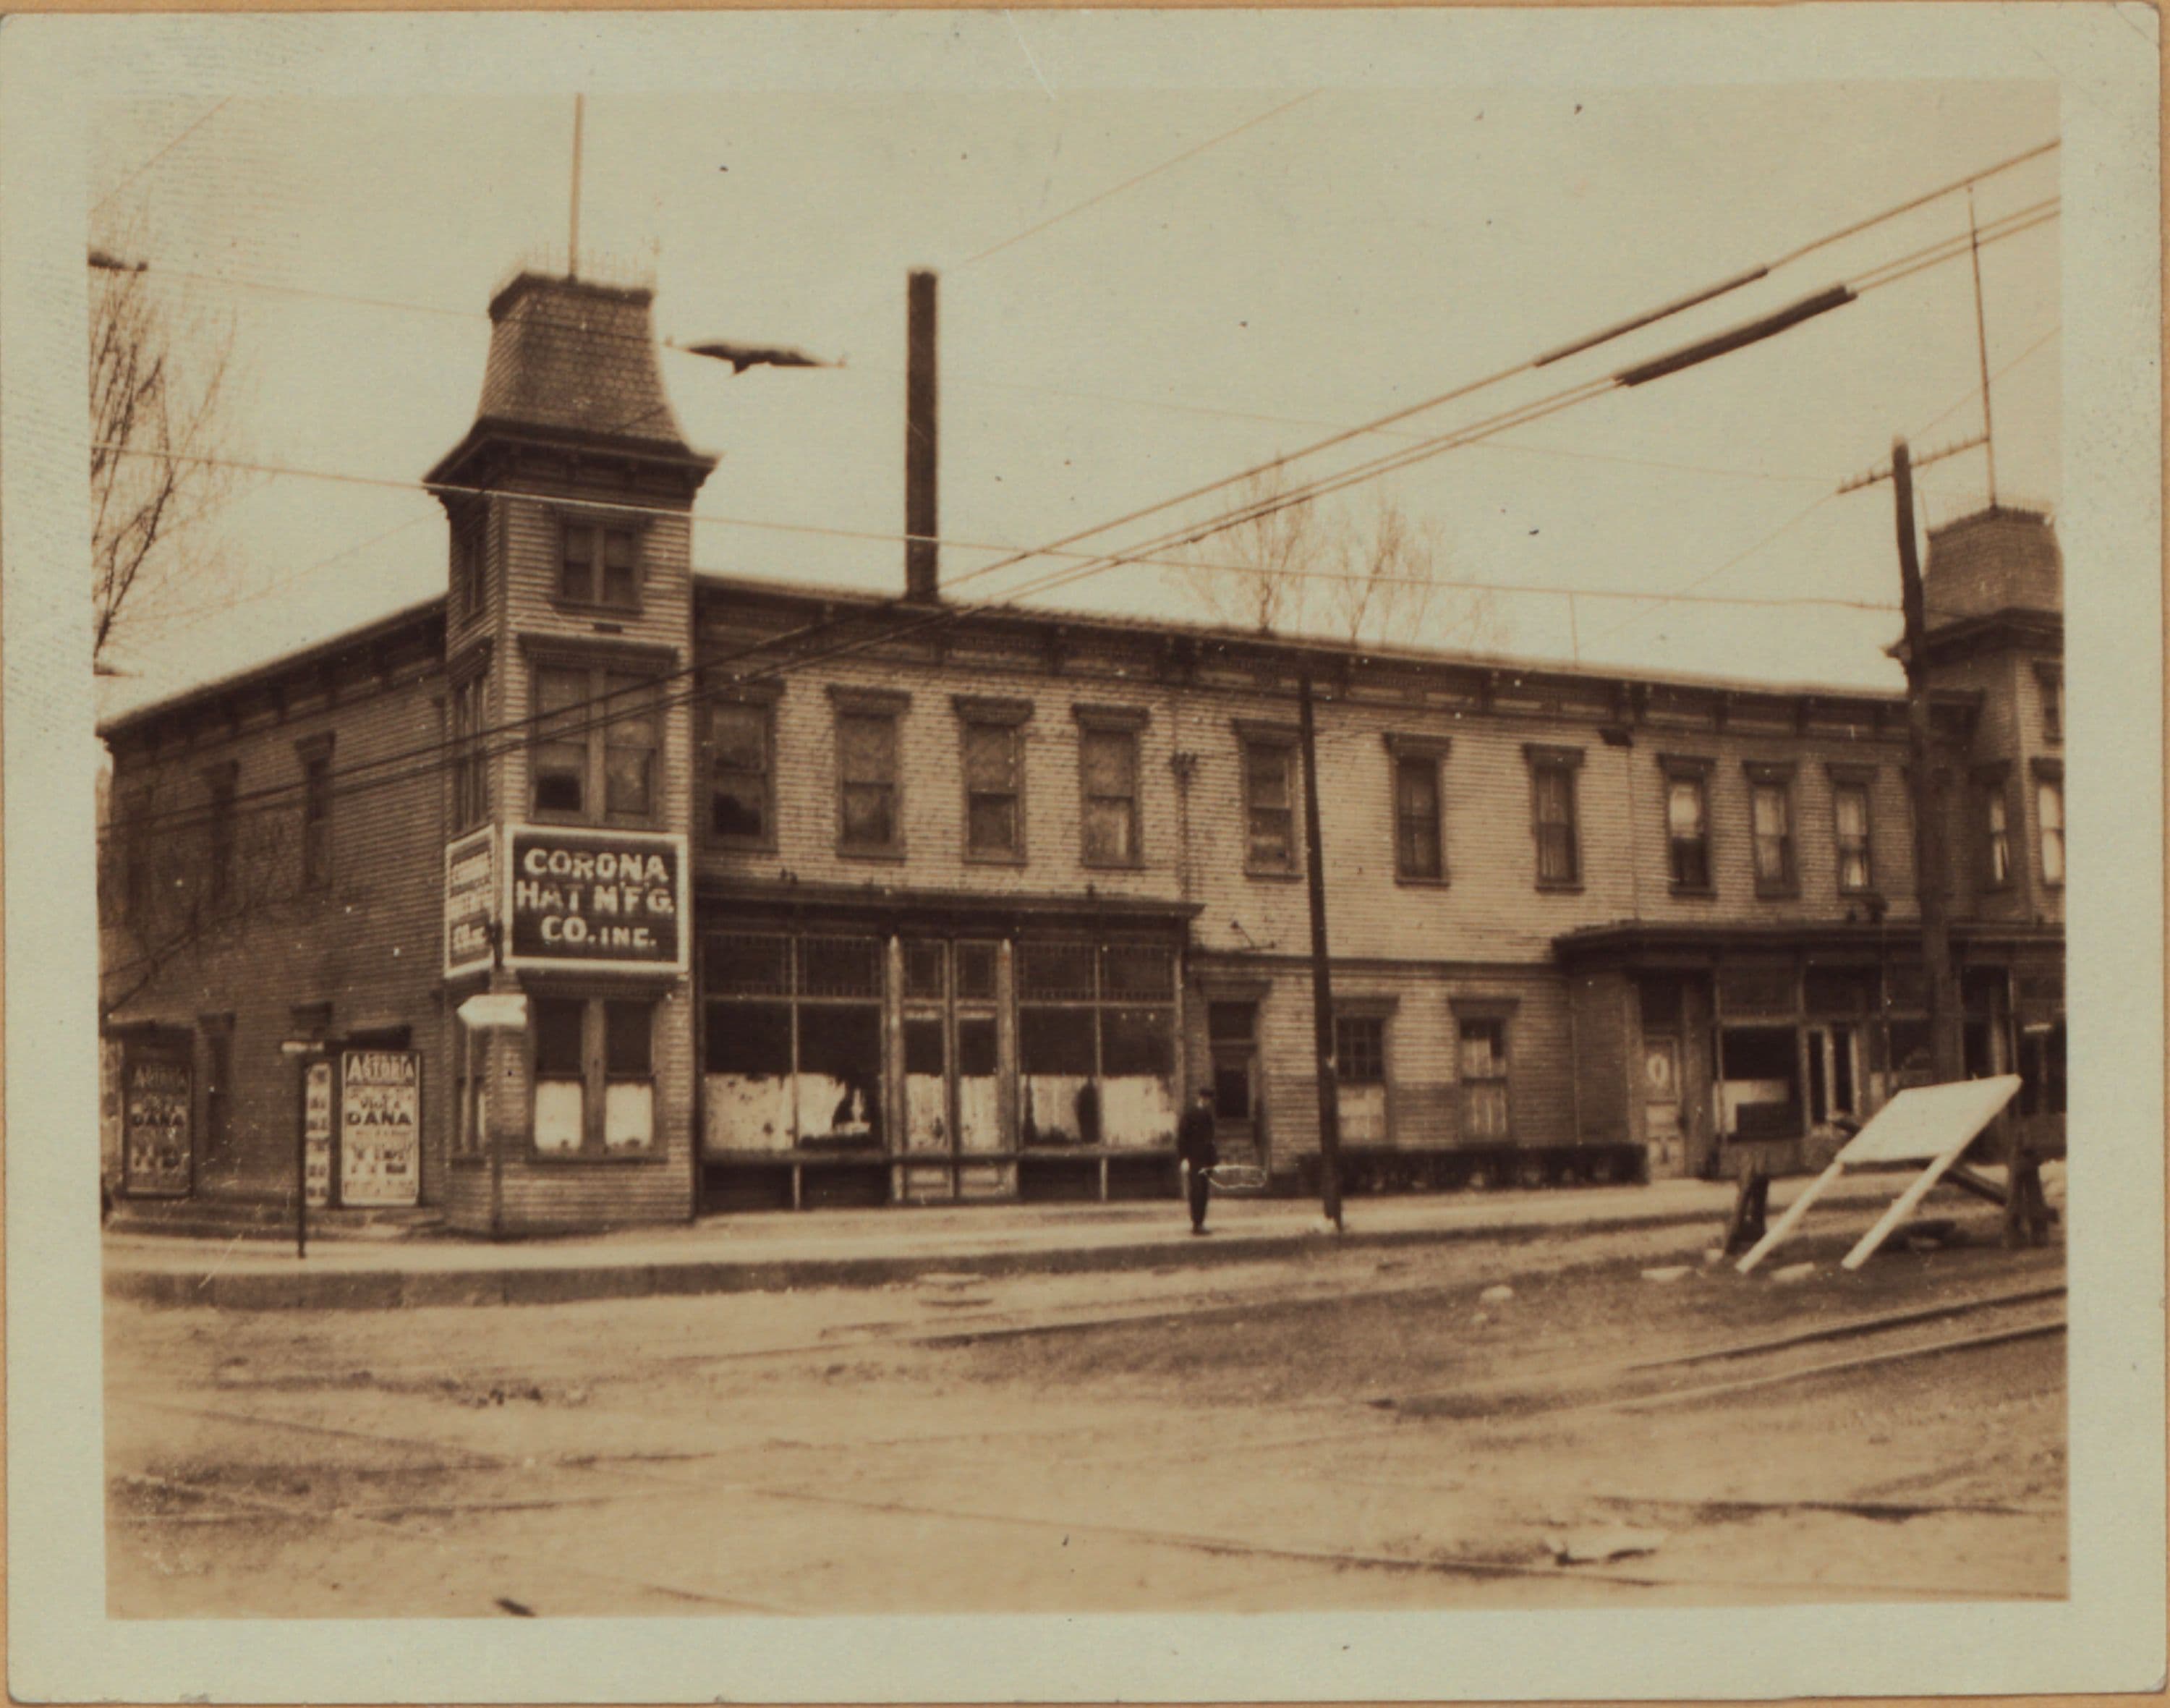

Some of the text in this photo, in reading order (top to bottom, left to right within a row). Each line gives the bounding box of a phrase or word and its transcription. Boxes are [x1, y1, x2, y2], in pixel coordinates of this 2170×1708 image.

[524, 848, 669, 882] CORONA
[516, 880, 584, 912] HAT
[541, 915, 596, 943] CO.
[346, 1112, 413, 1126] DANA
